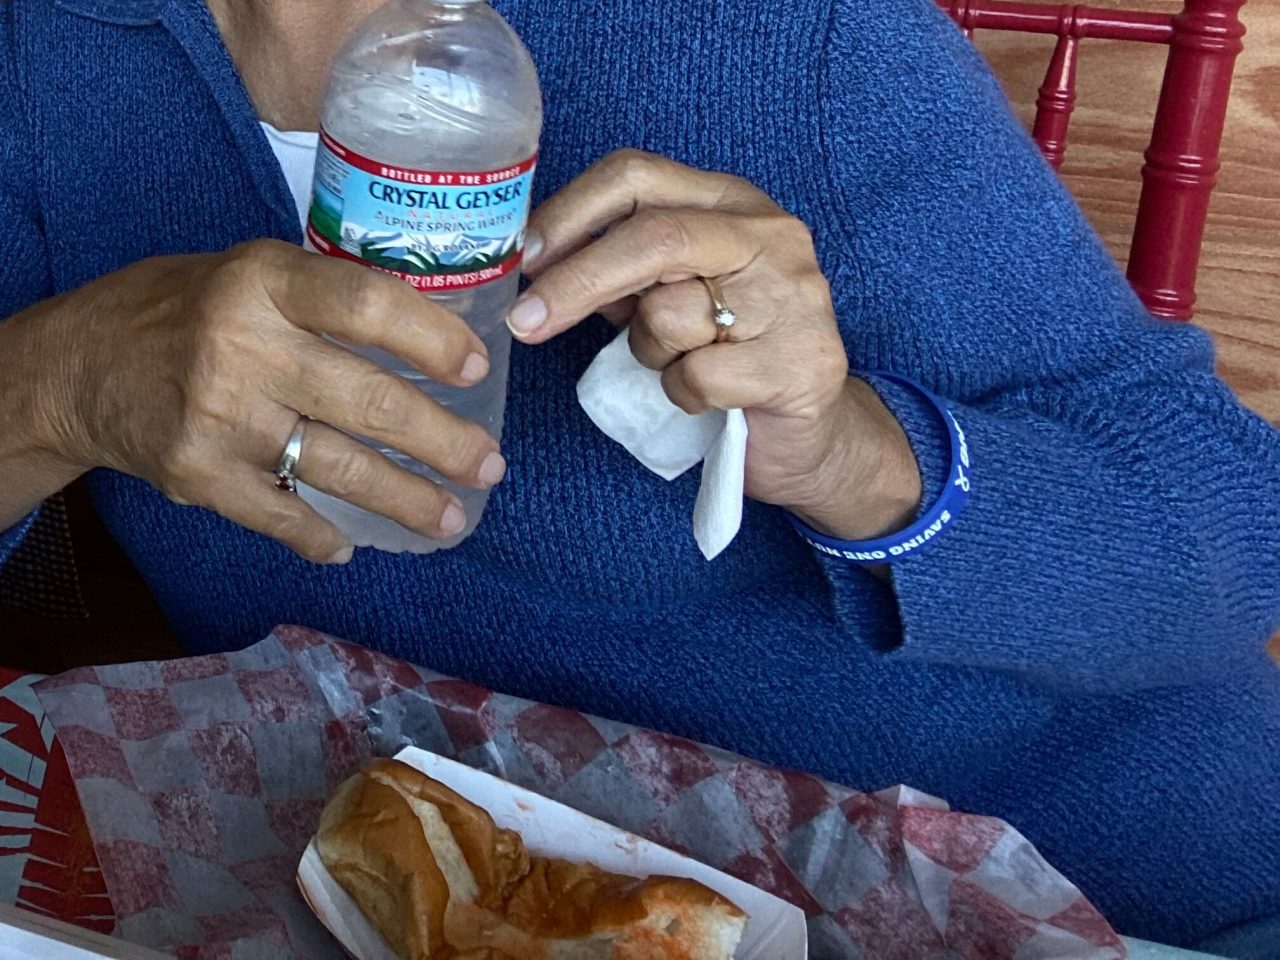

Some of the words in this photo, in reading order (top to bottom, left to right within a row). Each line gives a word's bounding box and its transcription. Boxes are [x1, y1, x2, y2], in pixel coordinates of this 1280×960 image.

[381, 166, 432, 184] BOTTLED
[438, 174, 453, 184] AT
[459, 174, 481, 184] THE
[486, 166, 521, 183] SOURCE
[369, 180, 451, 209] CRYSTAL
[456, 181, 523, 209] GEYSER
[374, 210, 423, 231] ALPINE
[426, 221, 476, 232] SPRING
[478, 213, 513, 229] WATER
[408, 209, 493, 219] NATURAL
[889, 510, 951, 556] SAVING
[842, 550, 887, 561] ONE
